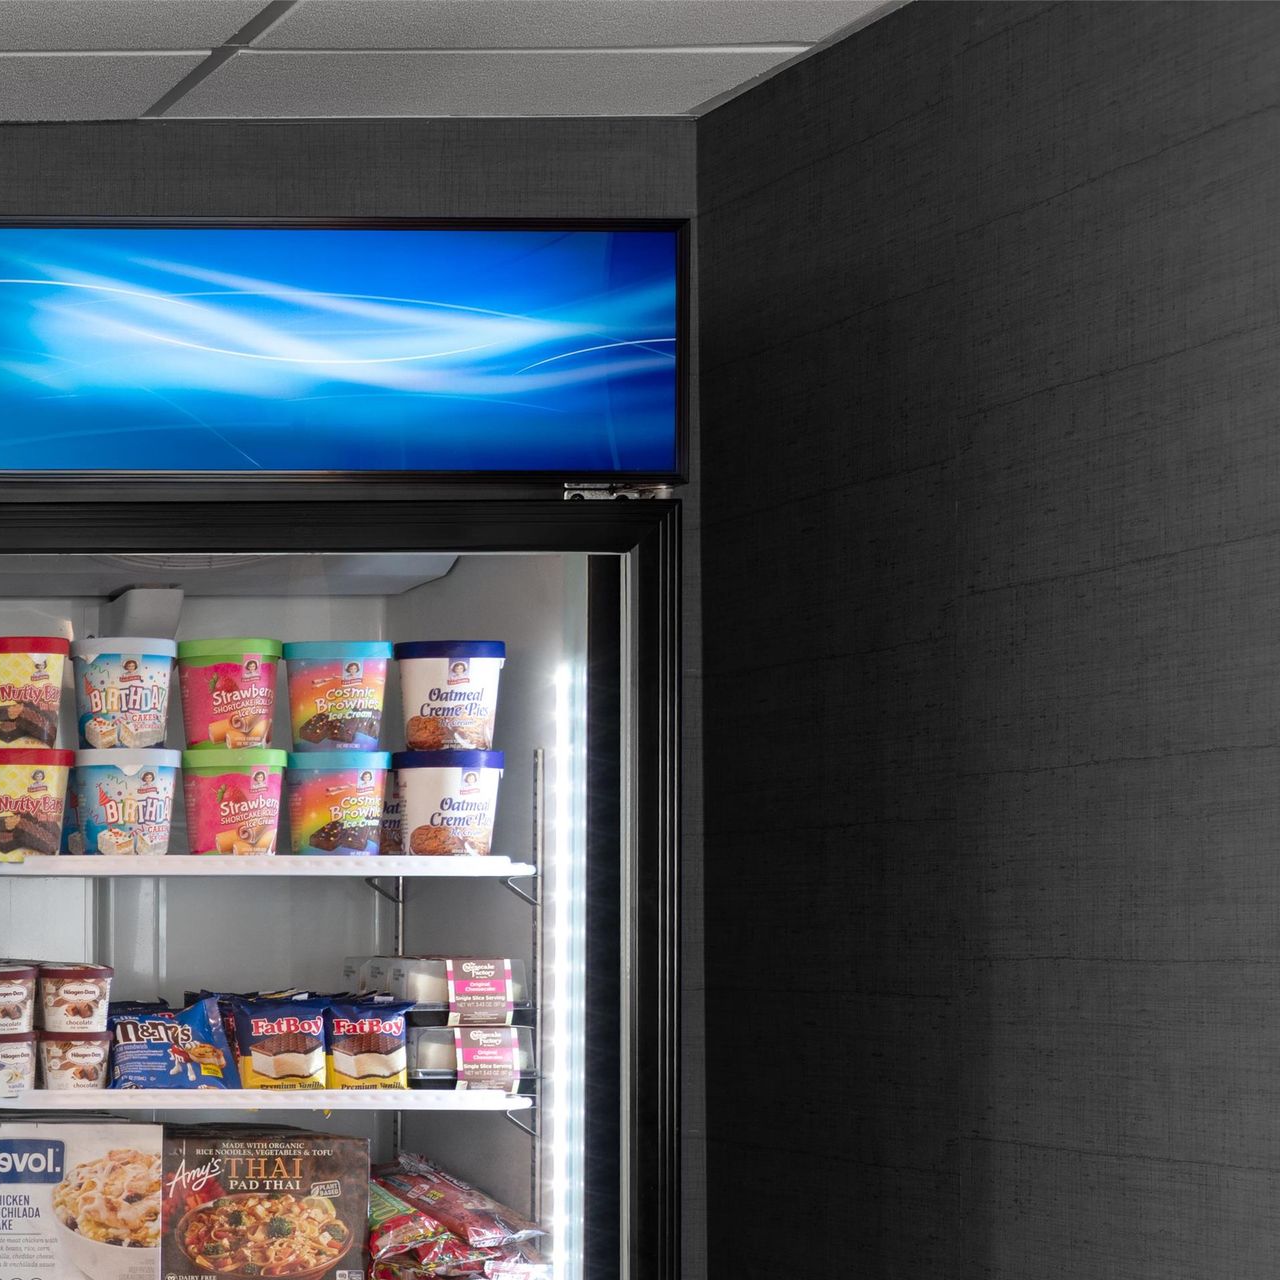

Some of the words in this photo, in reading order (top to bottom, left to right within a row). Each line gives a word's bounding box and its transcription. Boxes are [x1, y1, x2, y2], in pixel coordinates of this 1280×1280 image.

[326, 687, 374, 700] Cosmic
[429, 688, 484, 702] Oatmeal
[420, 703, 462, 717] Creme
[333, 1016, 405, 1035] FatBoy
[230, 1180, 260, 1190] PAD
[263, 1180, 301, 1190] THAI
